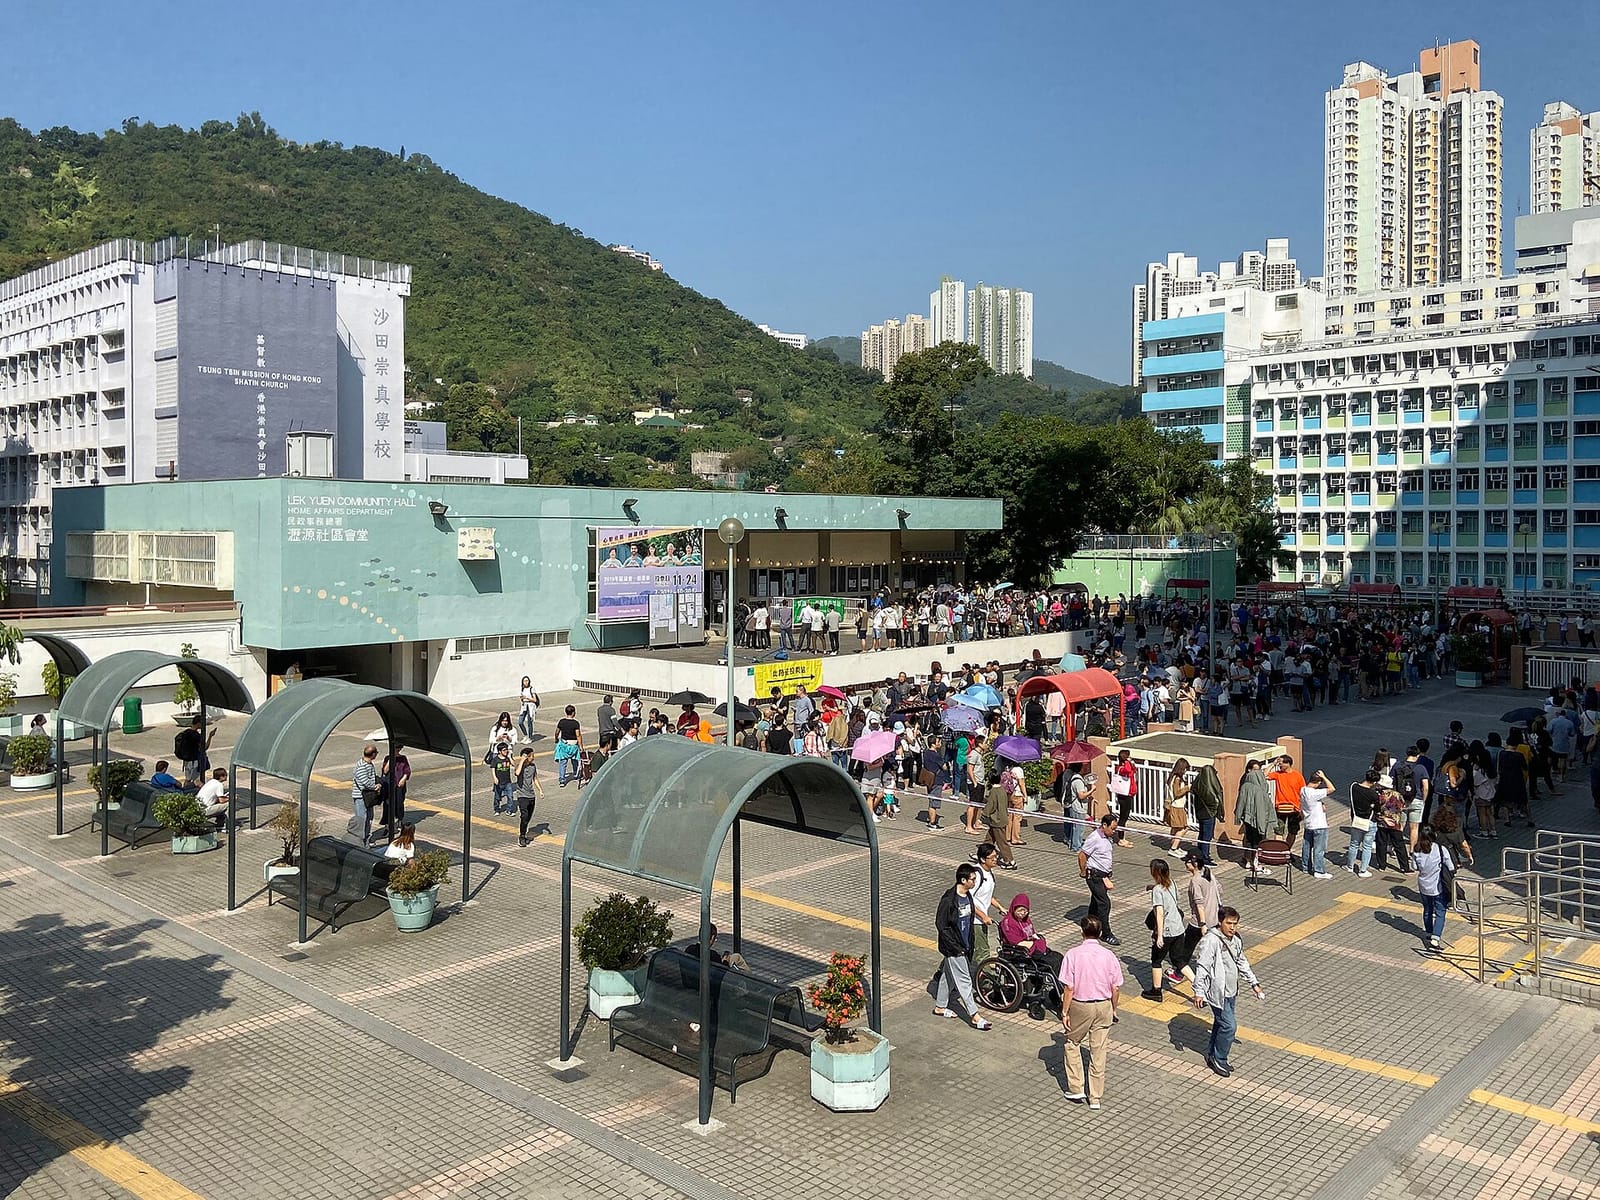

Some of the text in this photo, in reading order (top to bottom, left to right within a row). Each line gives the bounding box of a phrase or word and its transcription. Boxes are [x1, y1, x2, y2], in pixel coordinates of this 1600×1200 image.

[197, 365, 322, 384] TSUNG TSIN MISSION OF HONG KONG
[234, 378, 289, 389] SHATIN CHURCH
[373, 308, 391, 458] 沙田崇真學校
[287, 495, 416, 507] LEK YUEN COMMUNITY HALL
[287, 507, 394, 516] HOME AFFAIRS DEPARTMENT
[287, 528, 369, 542] 瀝源社區會堂
